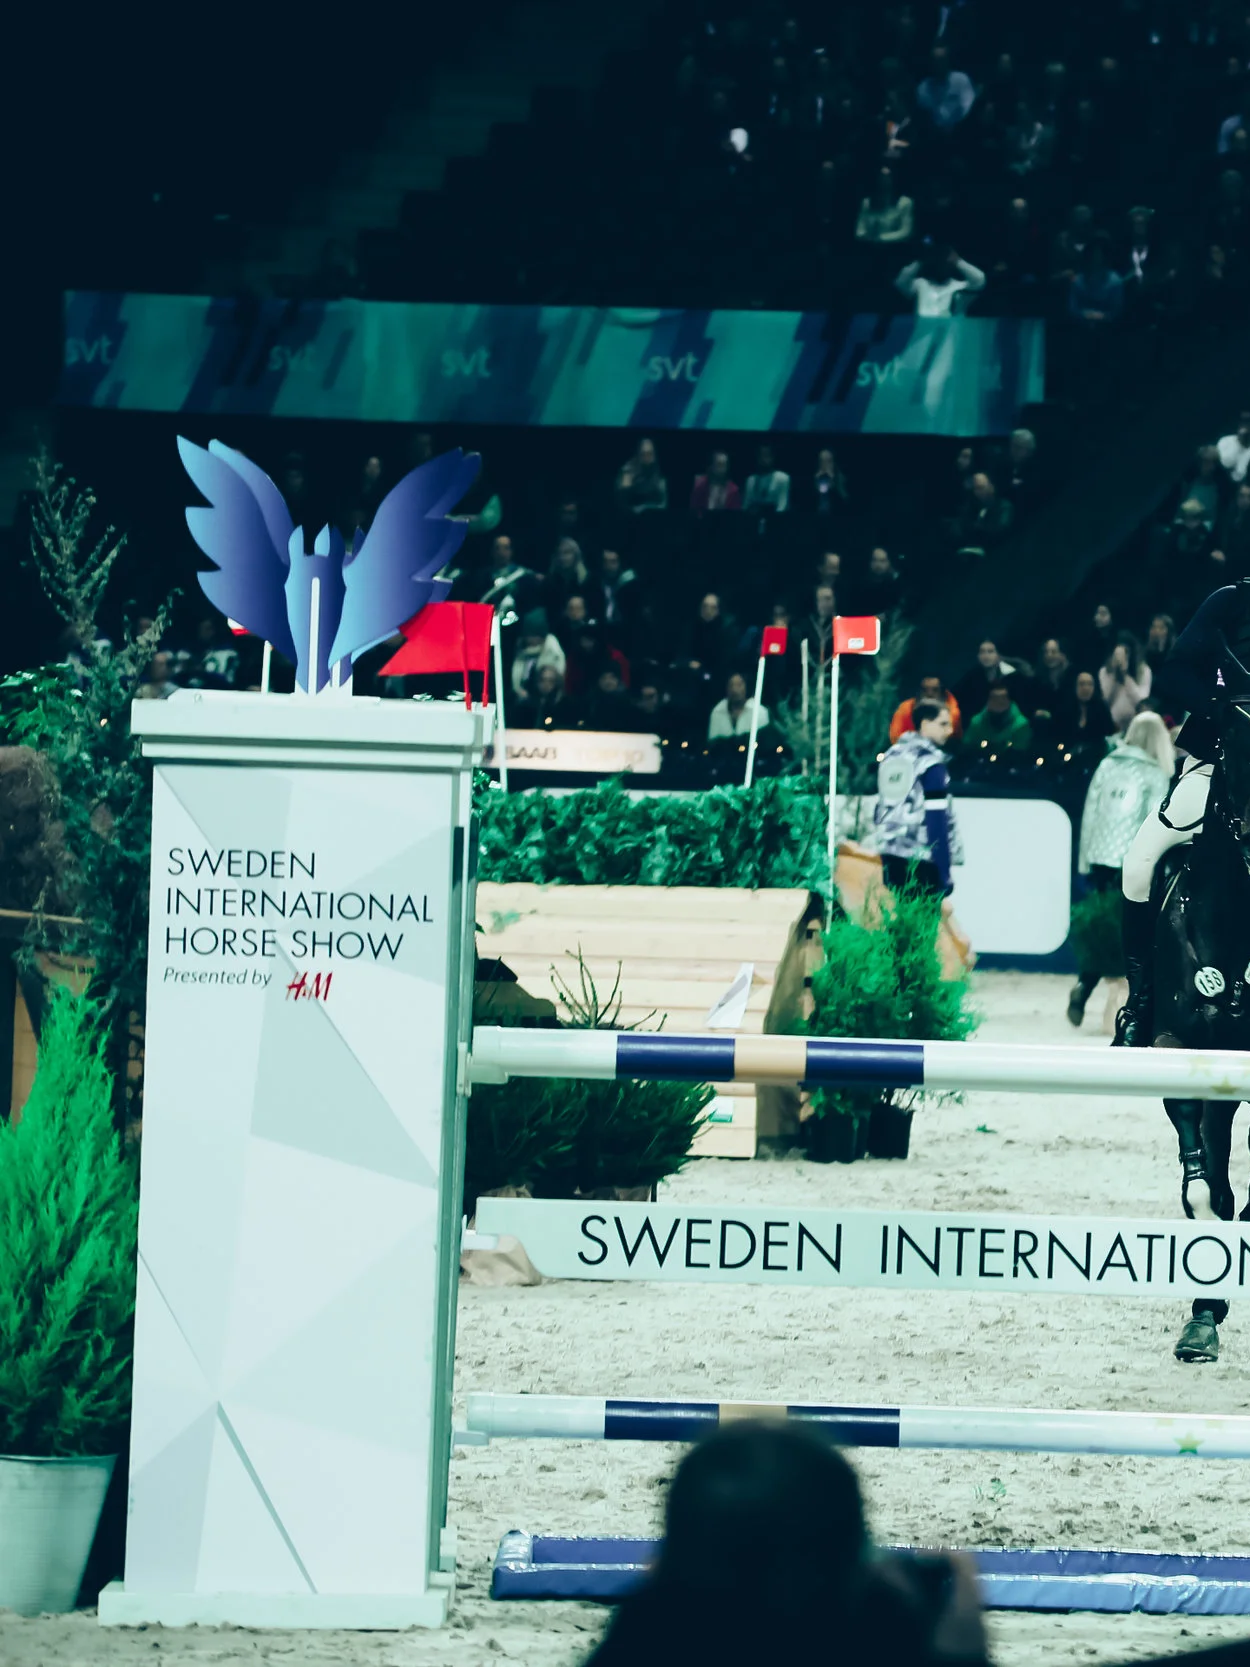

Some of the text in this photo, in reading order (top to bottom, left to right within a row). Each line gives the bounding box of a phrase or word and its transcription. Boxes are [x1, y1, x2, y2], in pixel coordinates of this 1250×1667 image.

[441, 347, 492, 378] svt
[648, 351, 698, 382] svt
[167, 847, 316, 880] SWEDEN
[166, 887, 434, 923] INTERNATIONAL
[165, 926, 404, 960] HORSE SHOW
[163, 966, 247, 985] Presented
[251, 967, 273, 989] by
[576, 1214, 843, 1274] SWEDEN
